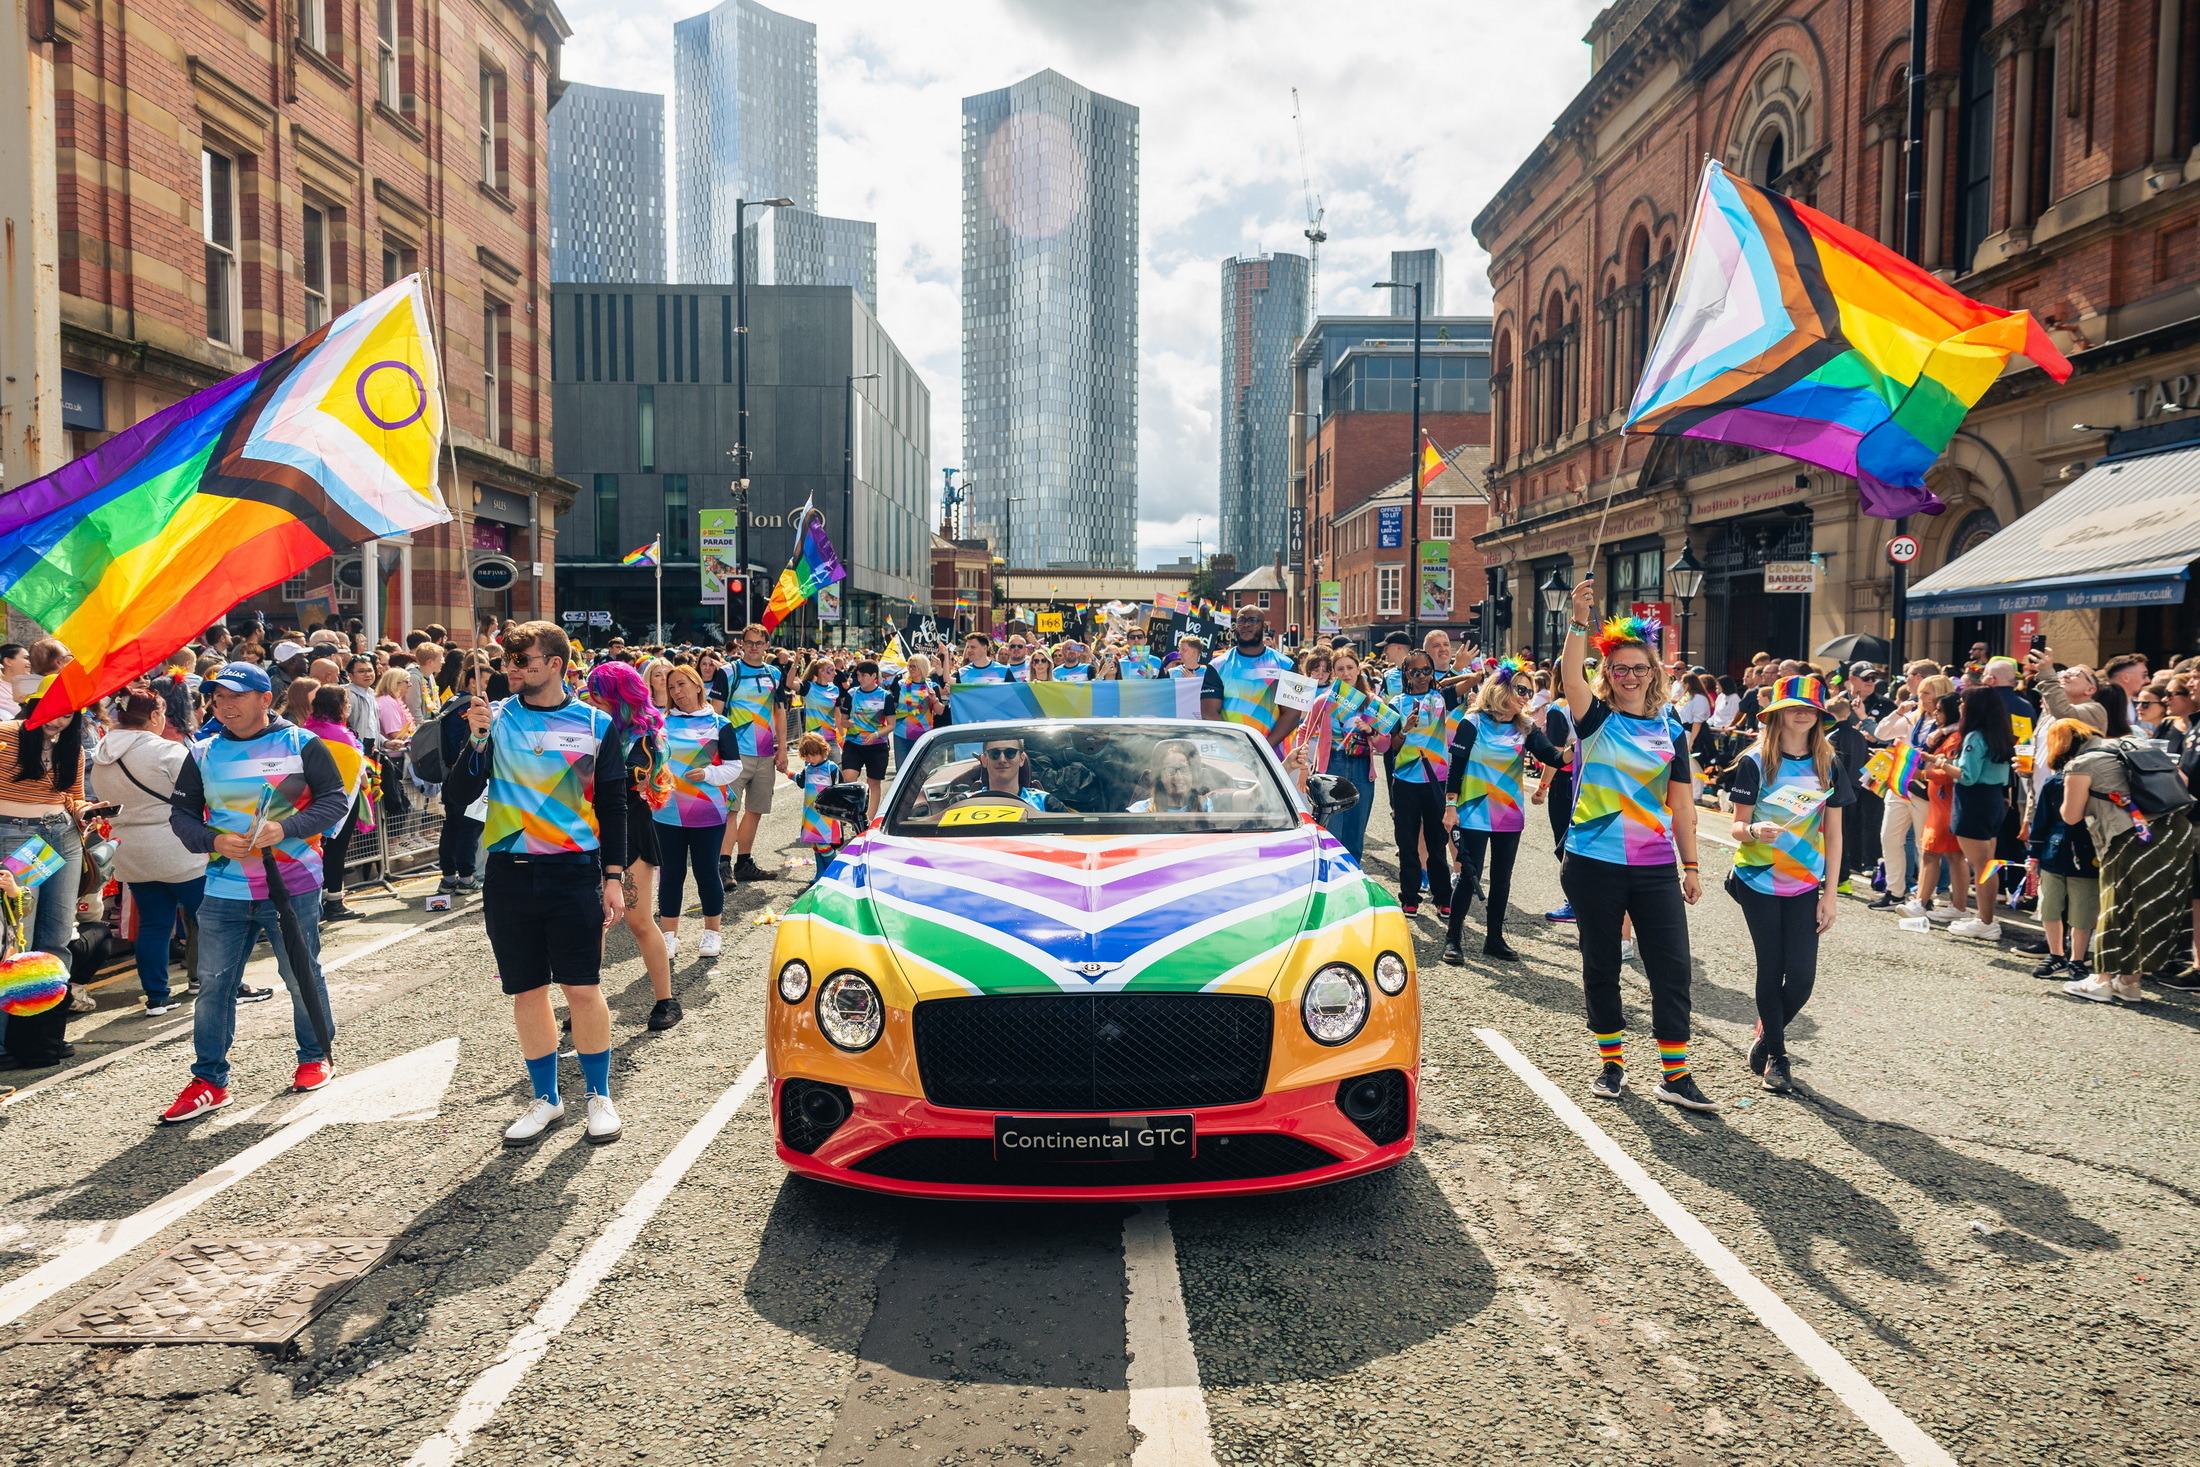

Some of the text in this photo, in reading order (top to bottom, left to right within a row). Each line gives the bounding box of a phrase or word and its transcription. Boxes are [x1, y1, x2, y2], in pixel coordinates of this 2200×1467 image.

[493, 499, 507, 511] SALES
[1697, 485, 1800, 514] Instituto Cervantes
[1524, 516, 1655, 557] Spanish Language and Cultural Centre
[1894, 543, 1915, 556] 20
[1768, 574, 1812, 583] BARBERS
[1041, 617, 1060, 629] 168
[1186, 617, 1201, 633] be
[911, 628, 949, 647] proud
[1174, 629, 1212, 649] prd
[1282, 693, 1309, 704] BENTLEY
[1329, 690, 1357, 710] BEPROUD
[953, 810, 1017, 822] 167
[21, 846, 52, 877] #BEPROUD
[1003, 1128, 1186, 1149] Continental GTC
